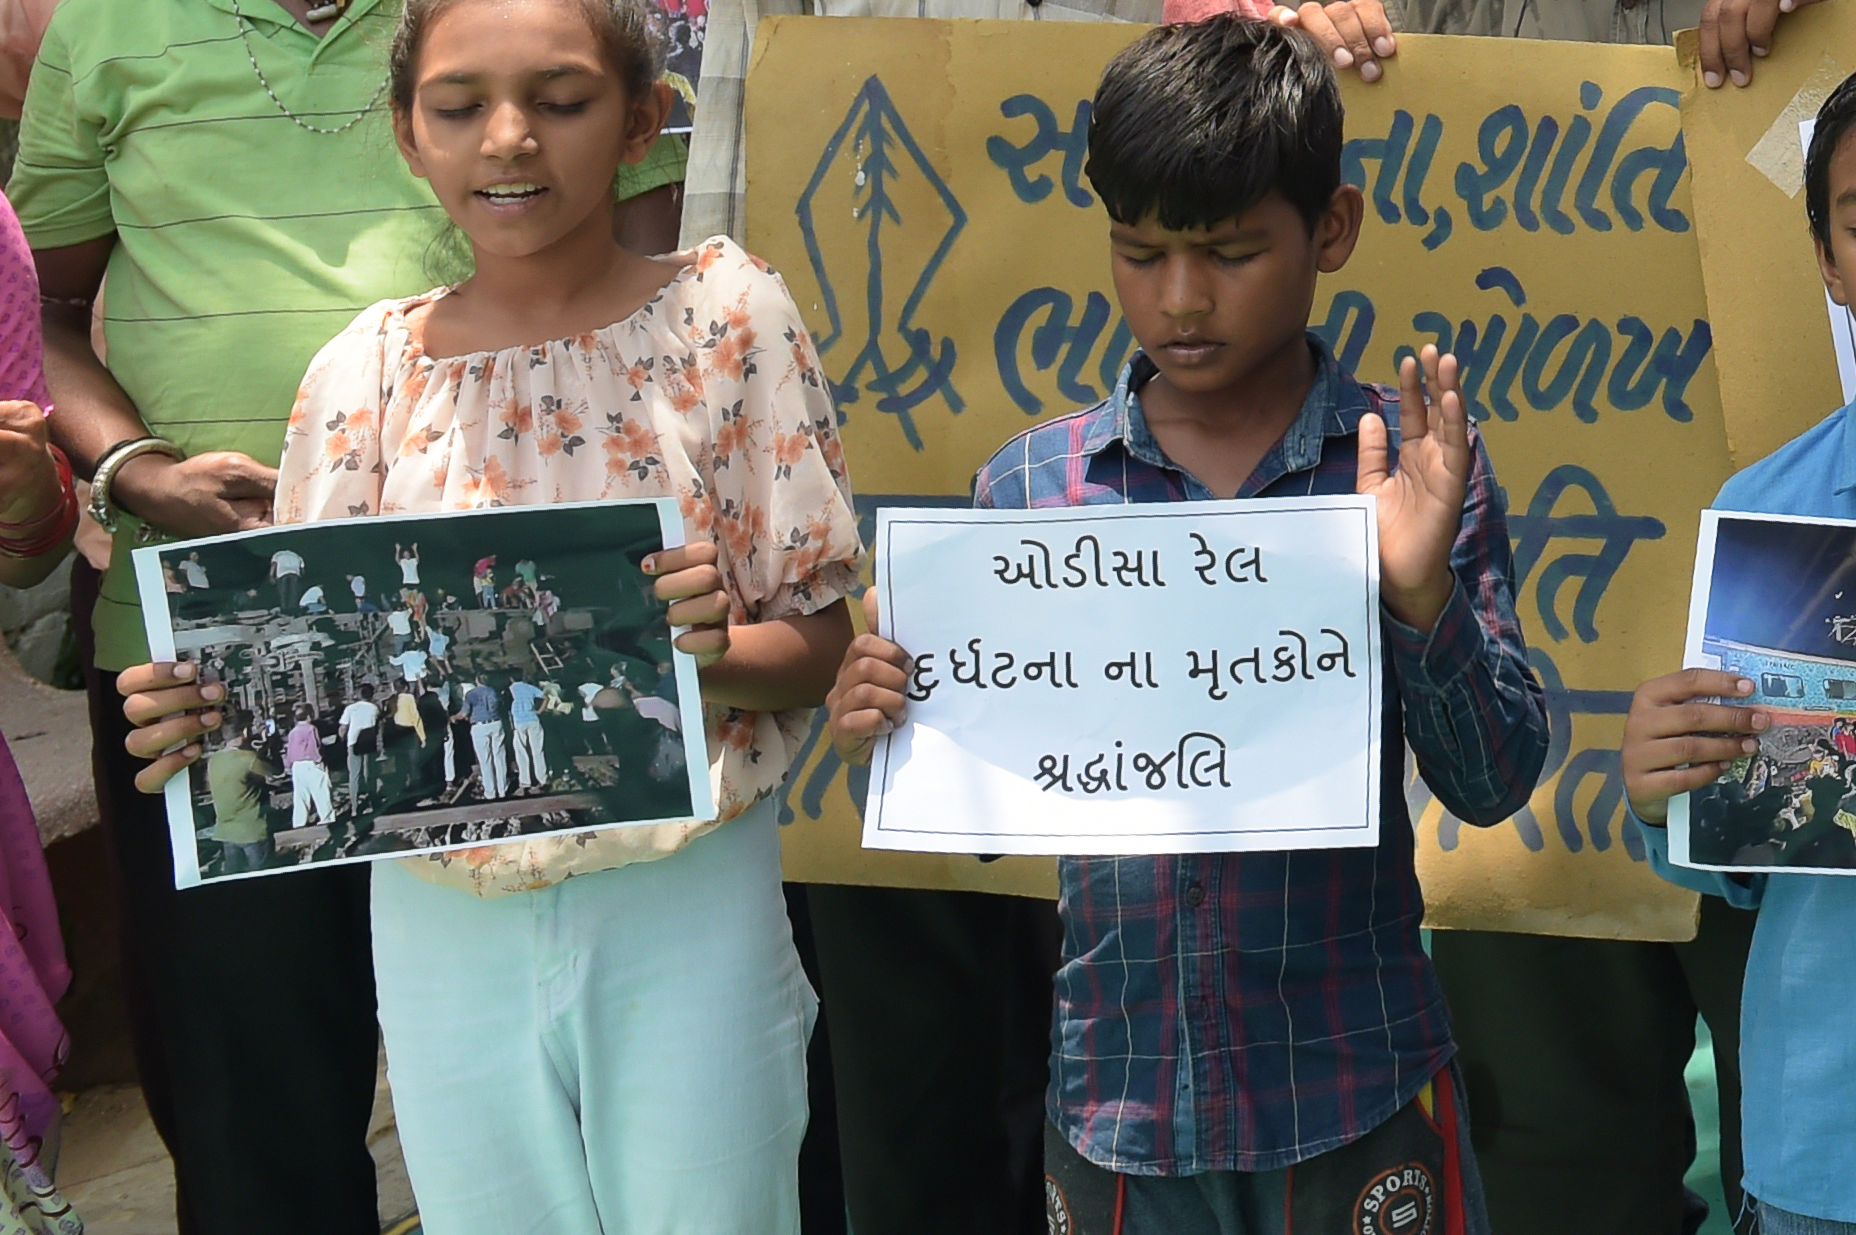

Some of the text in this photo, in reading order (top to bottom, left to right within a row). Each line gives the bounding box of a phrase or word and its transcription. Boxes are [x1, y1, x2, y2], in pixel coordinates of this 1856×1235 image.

[992, 532, 1268, 590] ઓડીસા રેલ
[1104, 651, 1159, 689] ના
[1185, 628, 1356, 701] મૃતકોને
[1033, 731, 1232, 794] શ્રદ્ધાંજલિ
